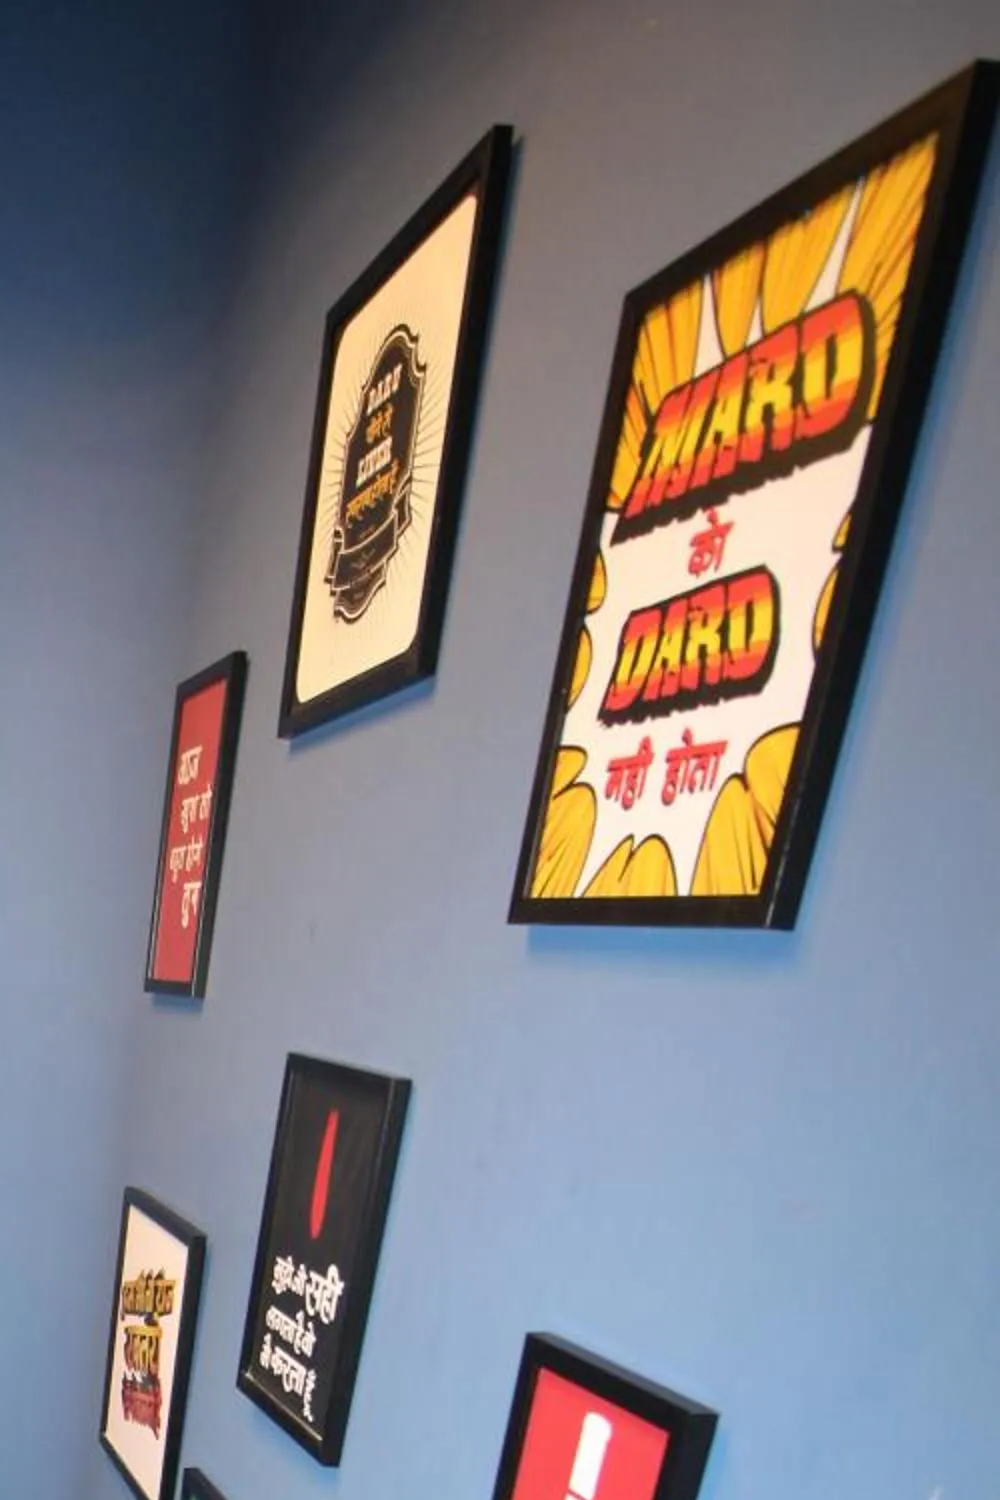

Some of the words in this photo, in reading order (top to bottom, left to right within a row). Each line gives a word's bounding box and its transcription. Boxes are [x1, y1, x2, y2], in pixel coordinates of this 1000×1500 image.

[612, 288, 875, 540] MARD
[688, 506, 734, 577] को
[598, 564, 780, 726] DARD
[661, 728, 728, 806] होता
